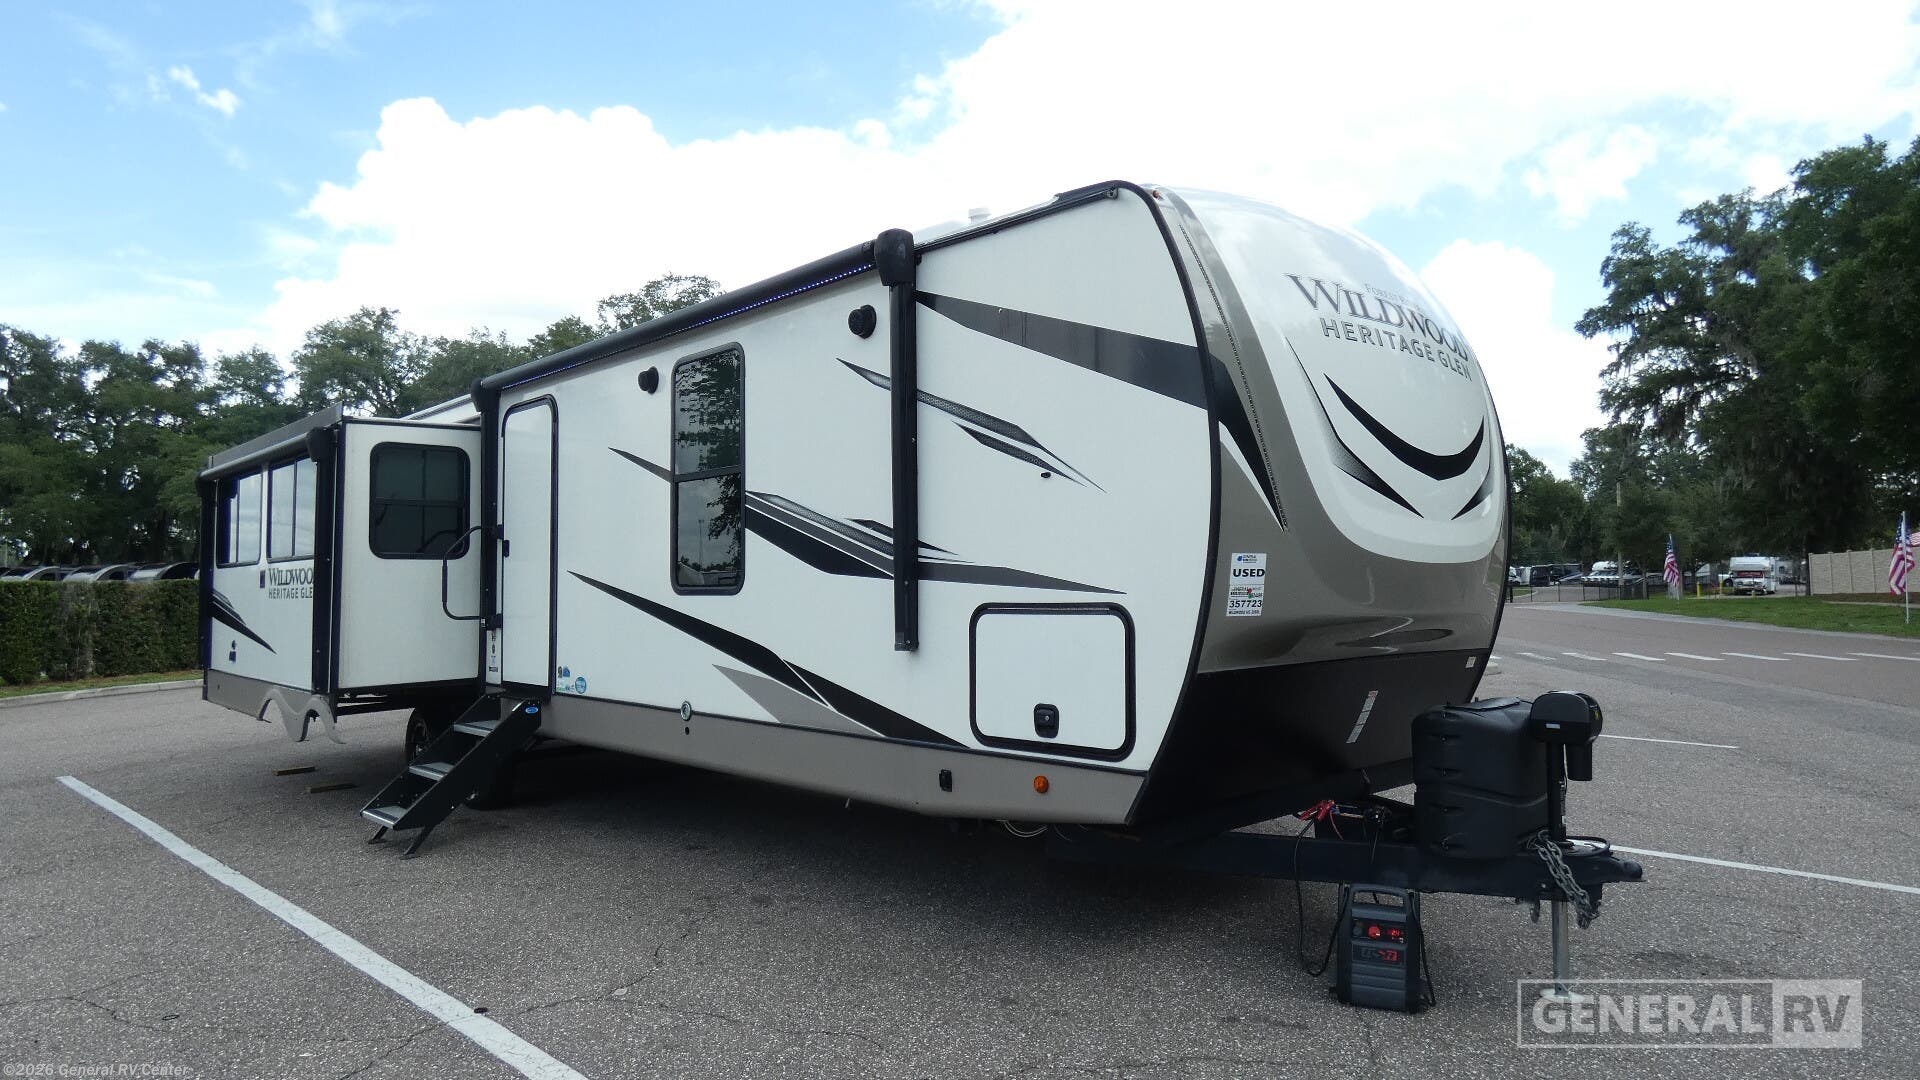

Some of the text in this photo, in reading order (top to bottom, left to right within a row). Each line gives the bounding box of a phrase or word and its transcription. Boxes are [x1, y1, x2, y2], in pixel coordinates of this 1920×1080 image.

[1284, 273, 1469, 361] WILDWOOD
[1320, 317, 1473, 381] HERITAGE GLEN
[268, 568, 314, 586] WILDWOO
[1233, 568, 1265, 577] USED
[268, 587, 313, 599] HERITAGE GLE
[1228, 600, 1262, 608] 357723
